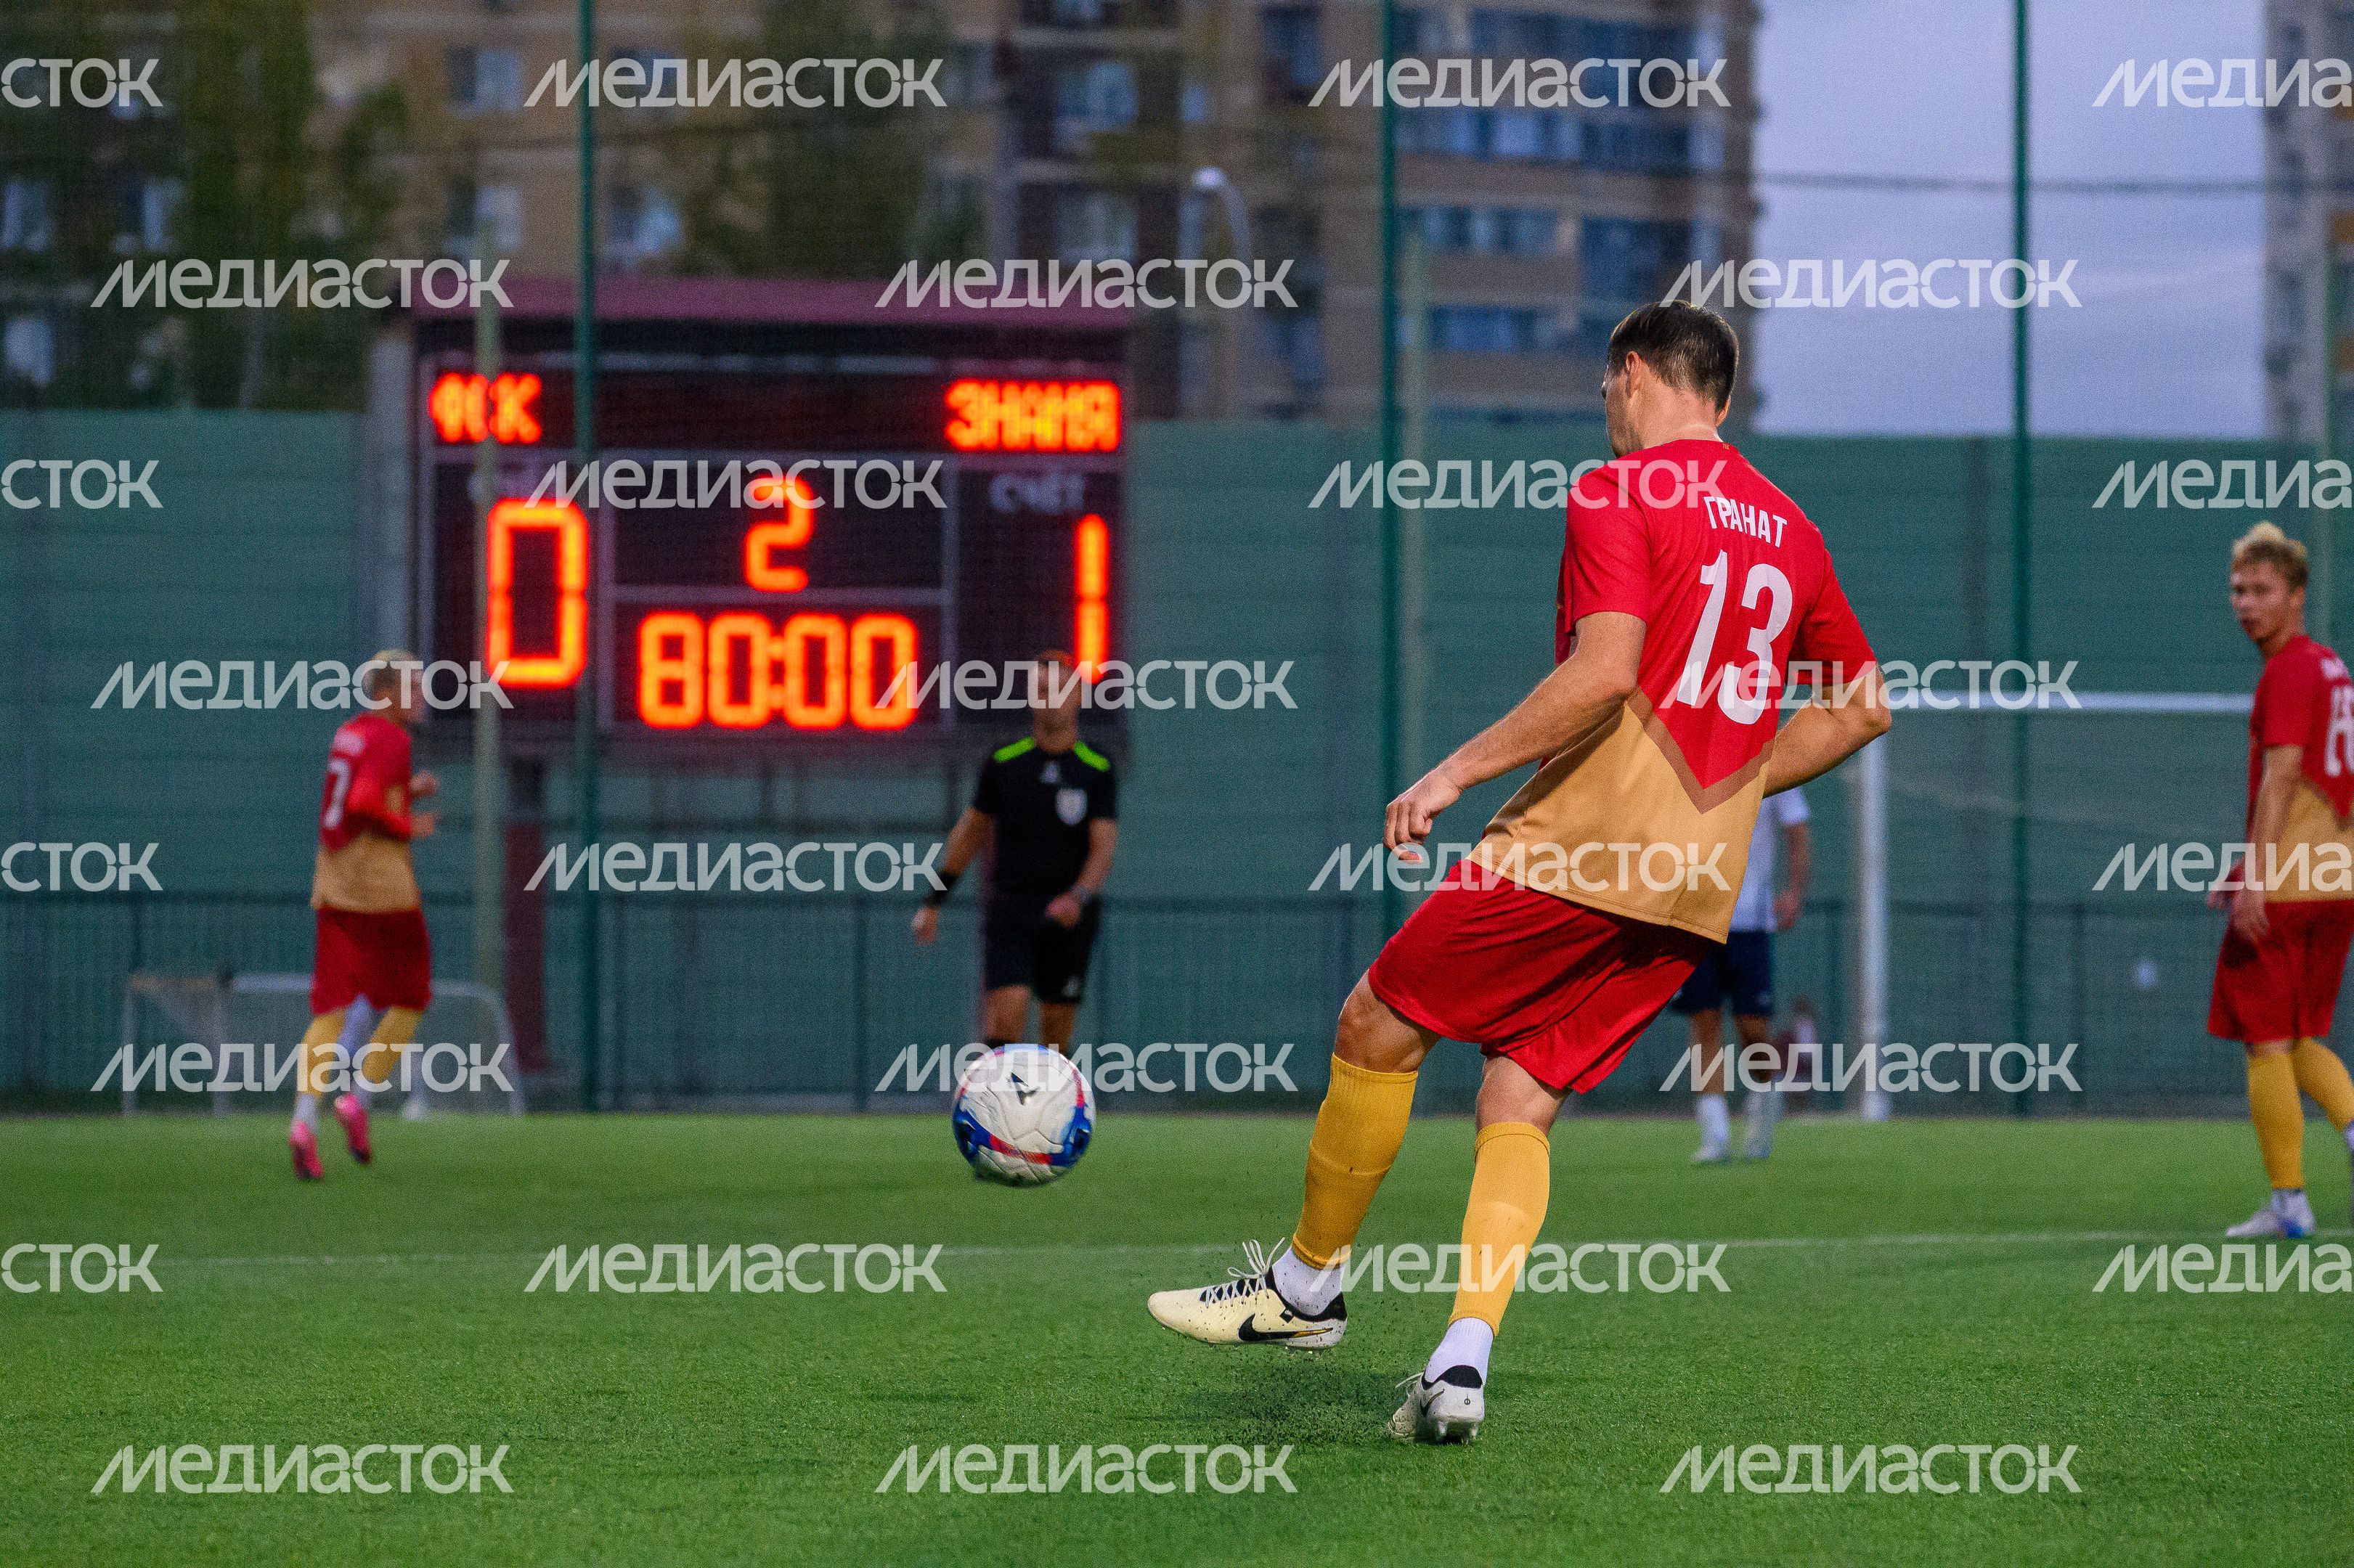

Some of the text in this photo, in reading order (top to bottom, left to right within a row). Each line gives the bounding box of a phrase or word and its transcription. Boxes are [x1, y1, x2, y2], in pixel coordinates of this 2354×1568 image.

[486, 499, 590, 689] 0
[743, 474, 815, 594] 2
[1703, 496, 1788, 547] ГРАНАТ
[637, 611, 919, 730] 80:00
[1075, 514, 1109, 685] 1
[1677, 549, 1793, 725] 13
